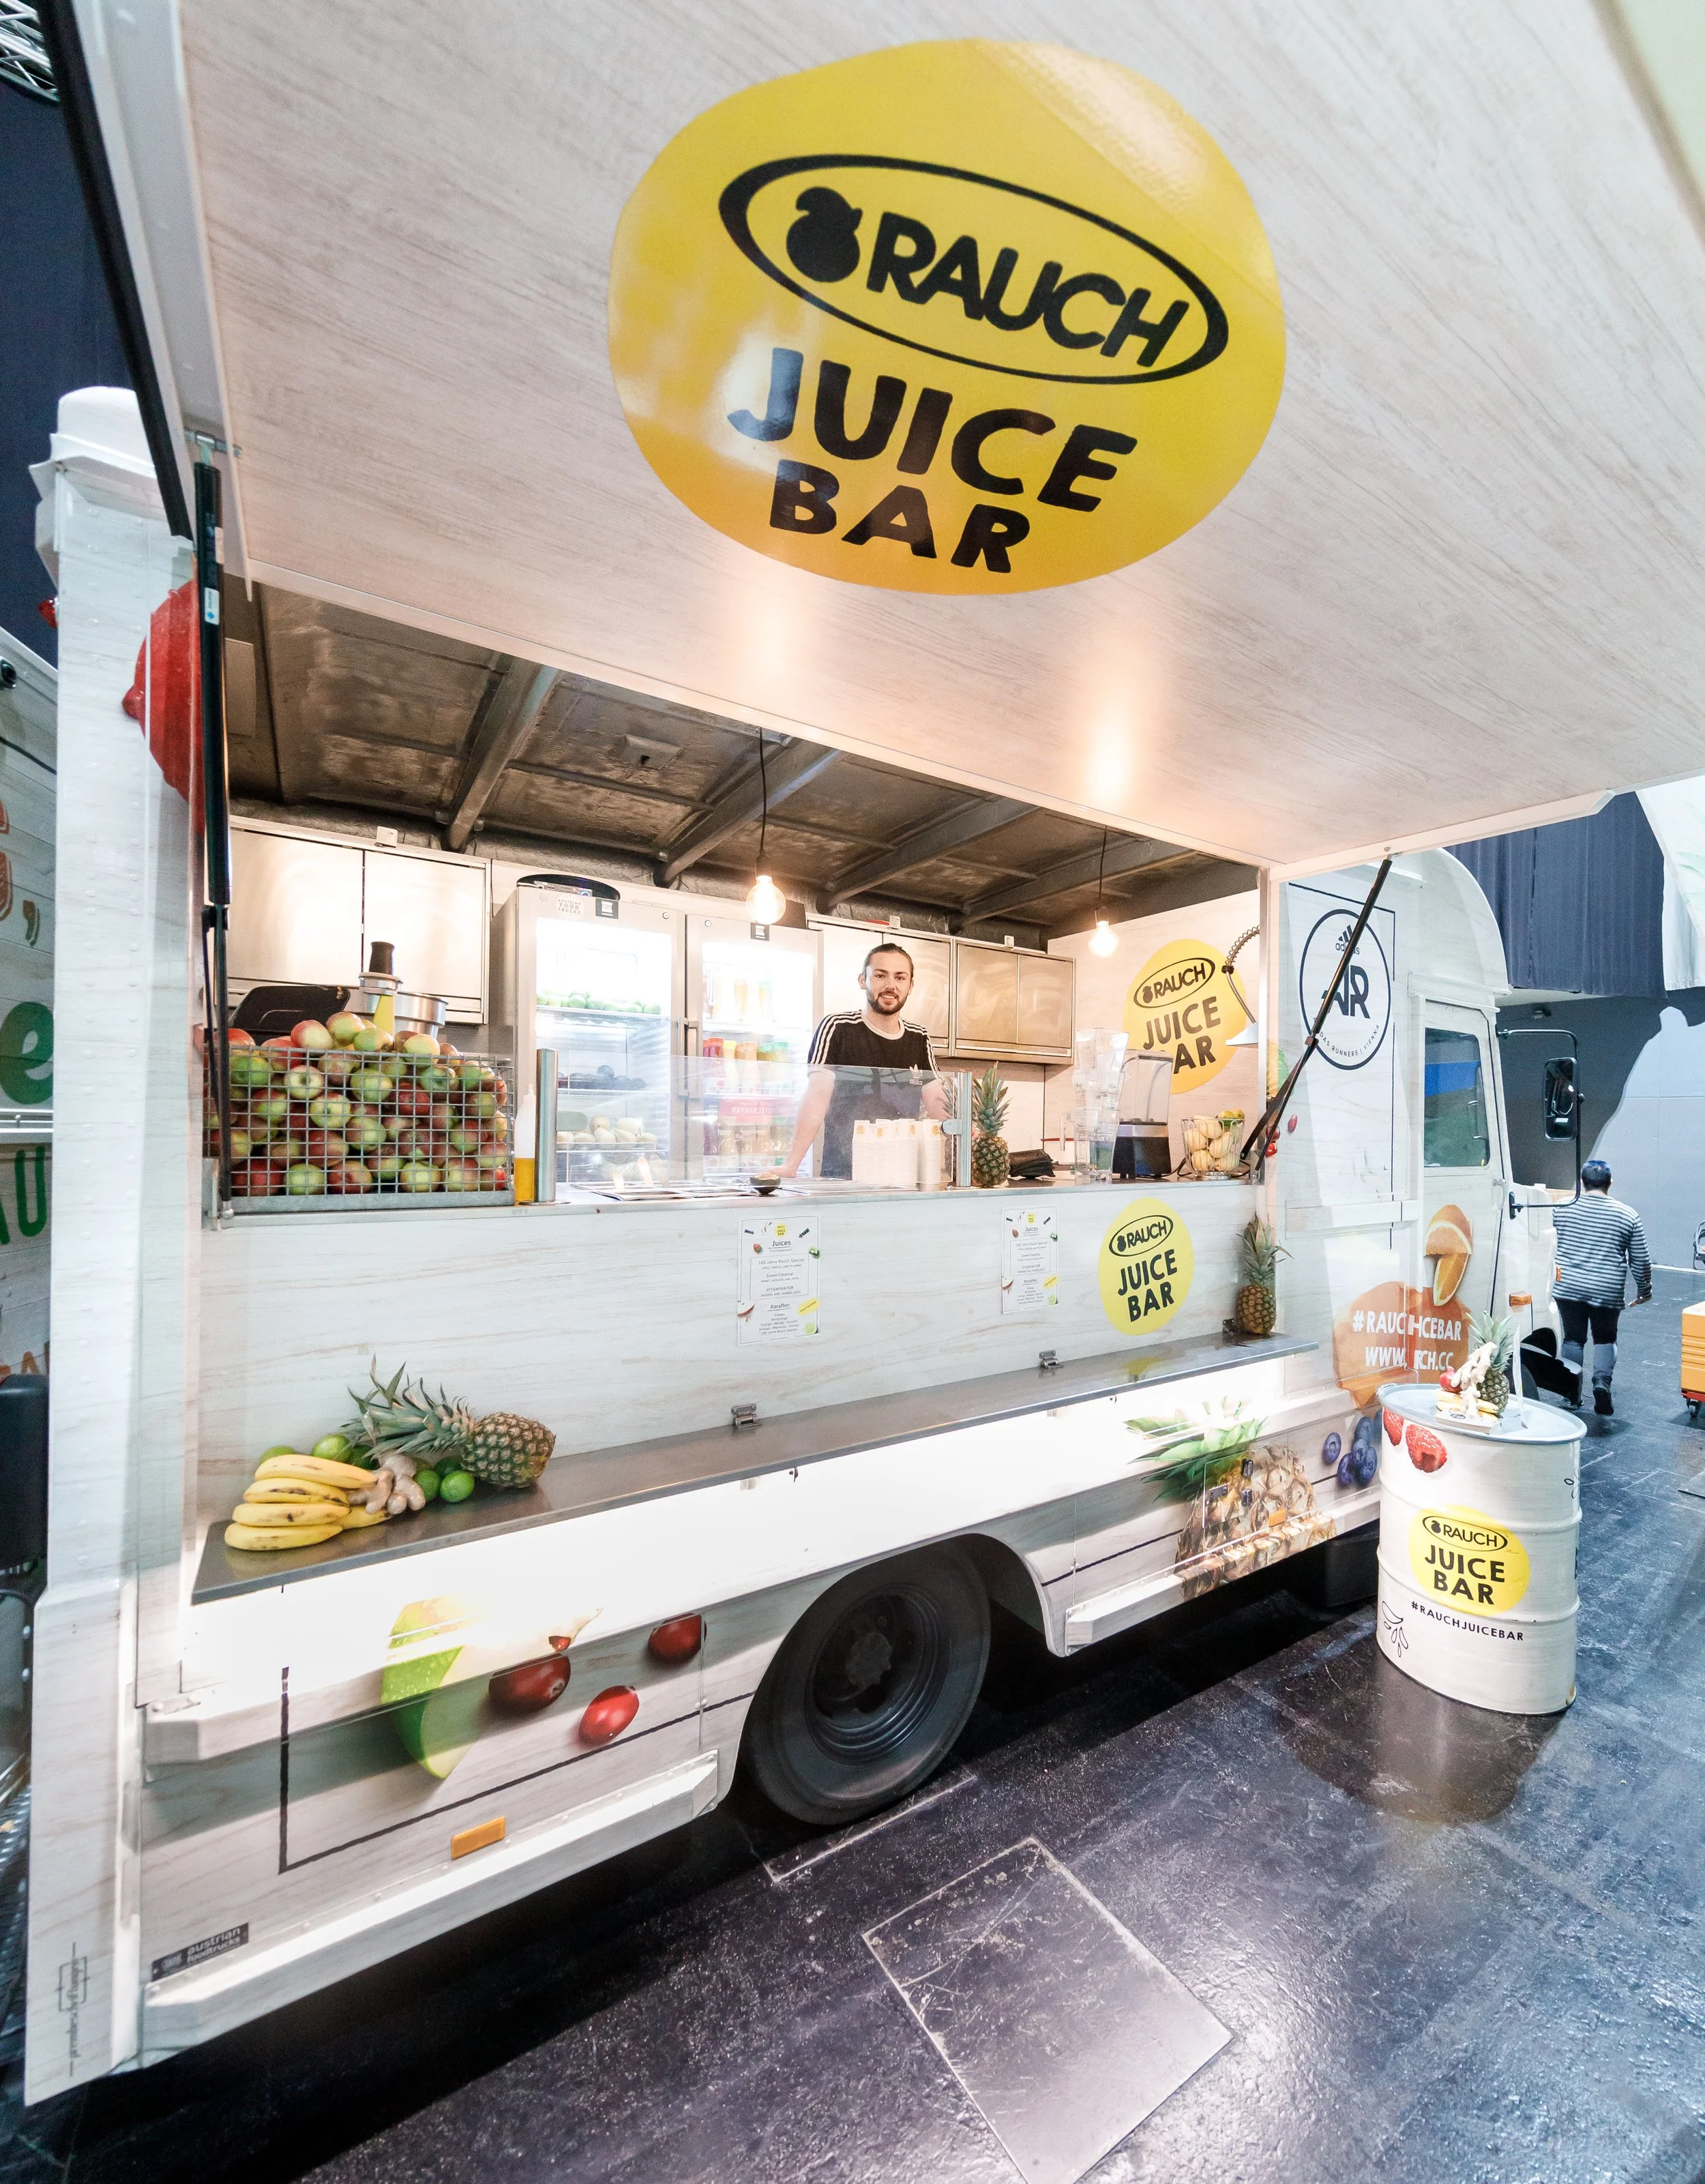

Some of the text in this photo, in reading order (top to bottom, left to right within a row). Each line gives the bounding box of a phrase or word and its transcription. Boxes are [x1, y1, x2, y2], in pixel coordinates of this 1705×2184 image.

[866, 211, 1189, 368] RAUCH
[726, 347, 1138, 513] JUICE
[769, 459, 1031, 573] BAR
[1153, 962, 1206, 999] RAUCH
[1143, 996, 1221, 1050] JUICE
[1331, 1045, 1359, 1058] RUNNERS
[1363, 1025, 1380, 1050] VIENNA
[1172, 1035, 1216, 1075] AR
[1126, 1220, 1168, 1248] RAUCH
[1118, 1248, 1177, 1296] JUICE
[1127, 1281, 1174, 1322] BAR
[1443, 1524, 1498, 1547] RAUCH
[1425, 1544, 1506, 1583] JUICE
[1434, 1570, 1494, 1605] BAR
[1411, 1600, 1524, 1641] #RAUCHJUICEBAR
